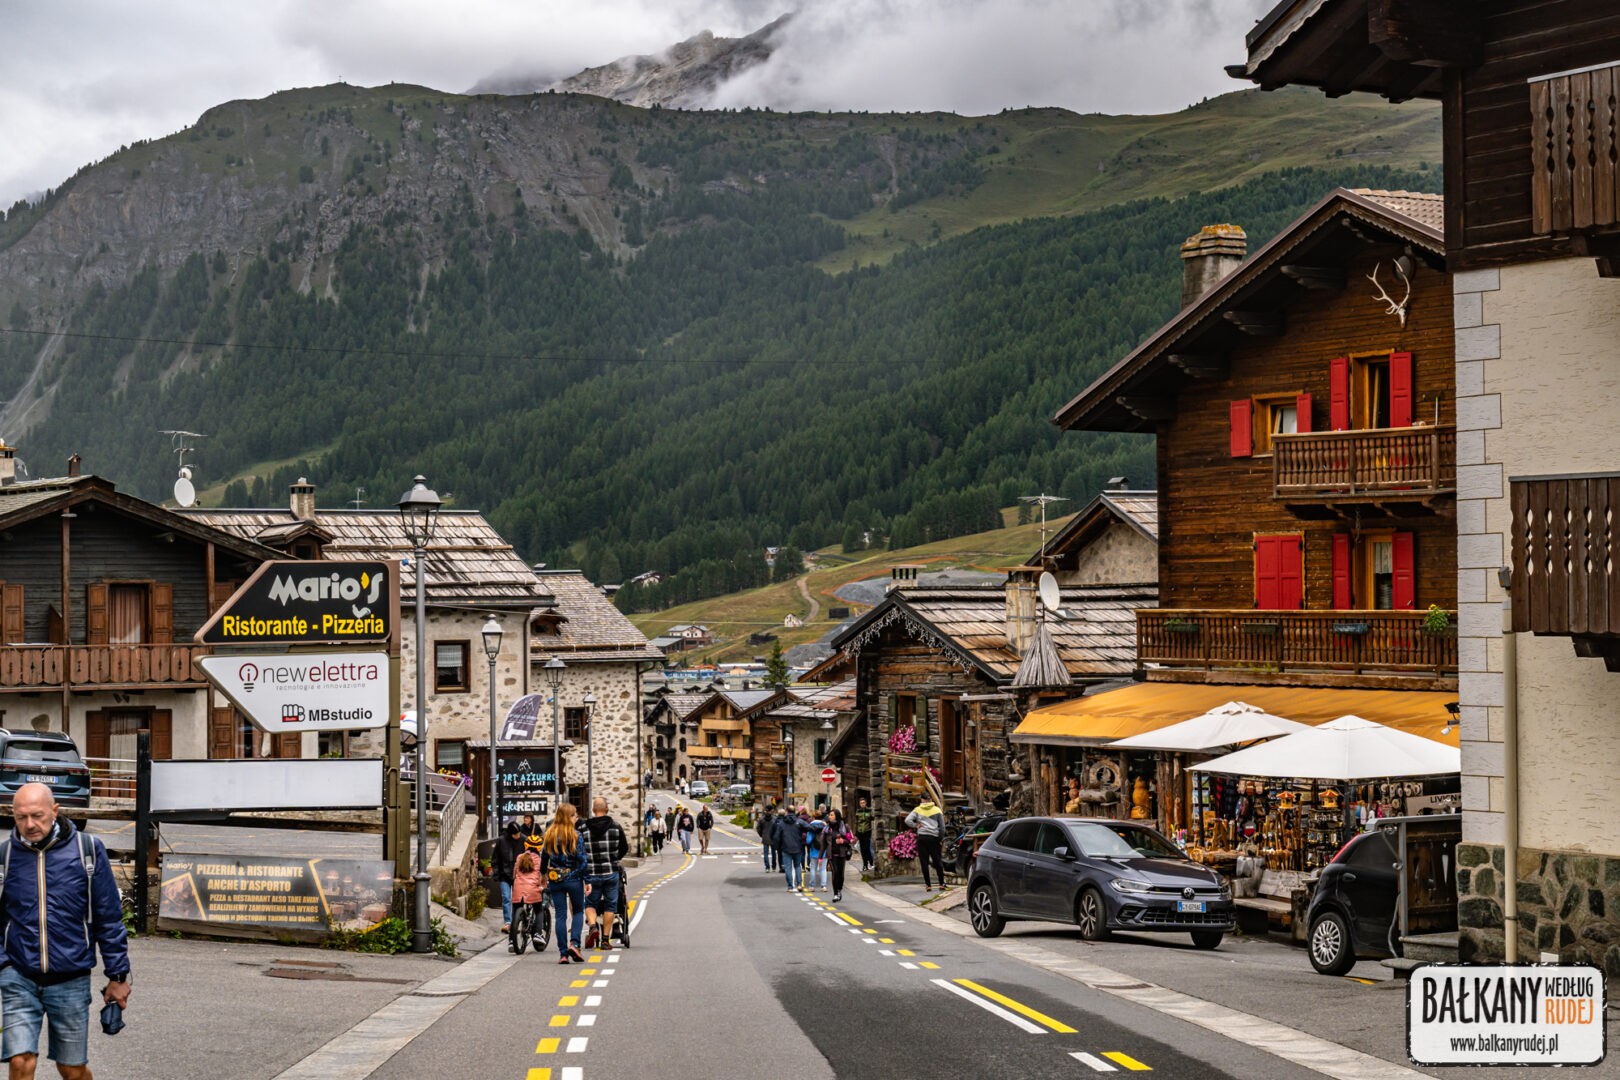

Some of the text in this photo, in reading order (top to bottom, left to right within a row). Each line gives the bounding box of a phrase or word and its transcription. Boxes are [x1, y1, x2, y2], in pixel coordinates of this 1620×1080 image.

[268, 572, 384, 606] Mario's
[223, 615, 307, 636] Ristorante
[322, 613, 384, 635] Pizzeria
[263, 661, 378, 683] newelettra
[309, 708, 373, 721] MBstudio
[196, 864, 303, 878] PIZZERIA & RISTORANTE
[208, 879, 291, 892] ANCHE D'ASPORTO
[209, 893, 226, 901] PIZZA
[271, 895, 286, 903] ALSO
